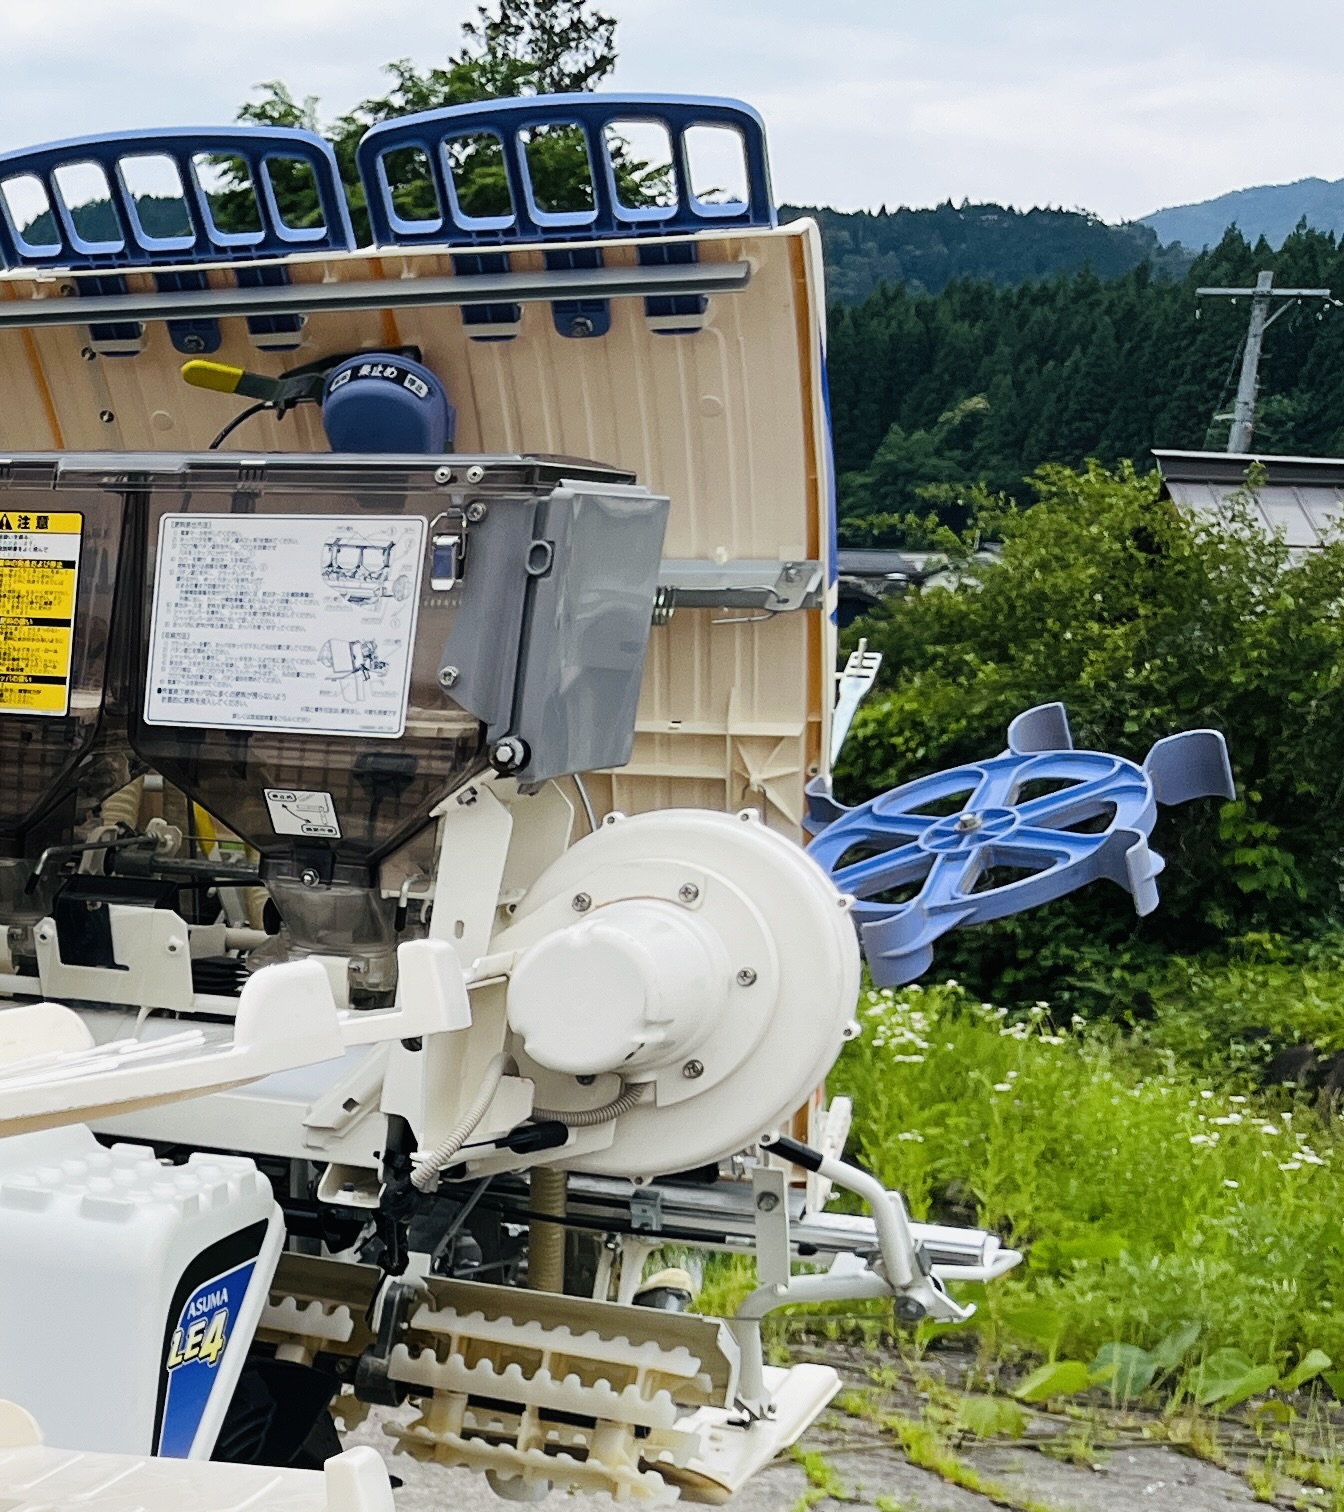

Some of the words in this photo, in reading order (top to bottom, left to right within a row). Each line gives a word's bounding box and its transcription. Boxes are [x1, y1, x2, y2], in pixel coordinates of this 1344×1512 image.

[17, 515, 49, 530] 注意
[187, 1287, 229, 1320] ASUMA
[167, 1308, 228, 1368] LE4
